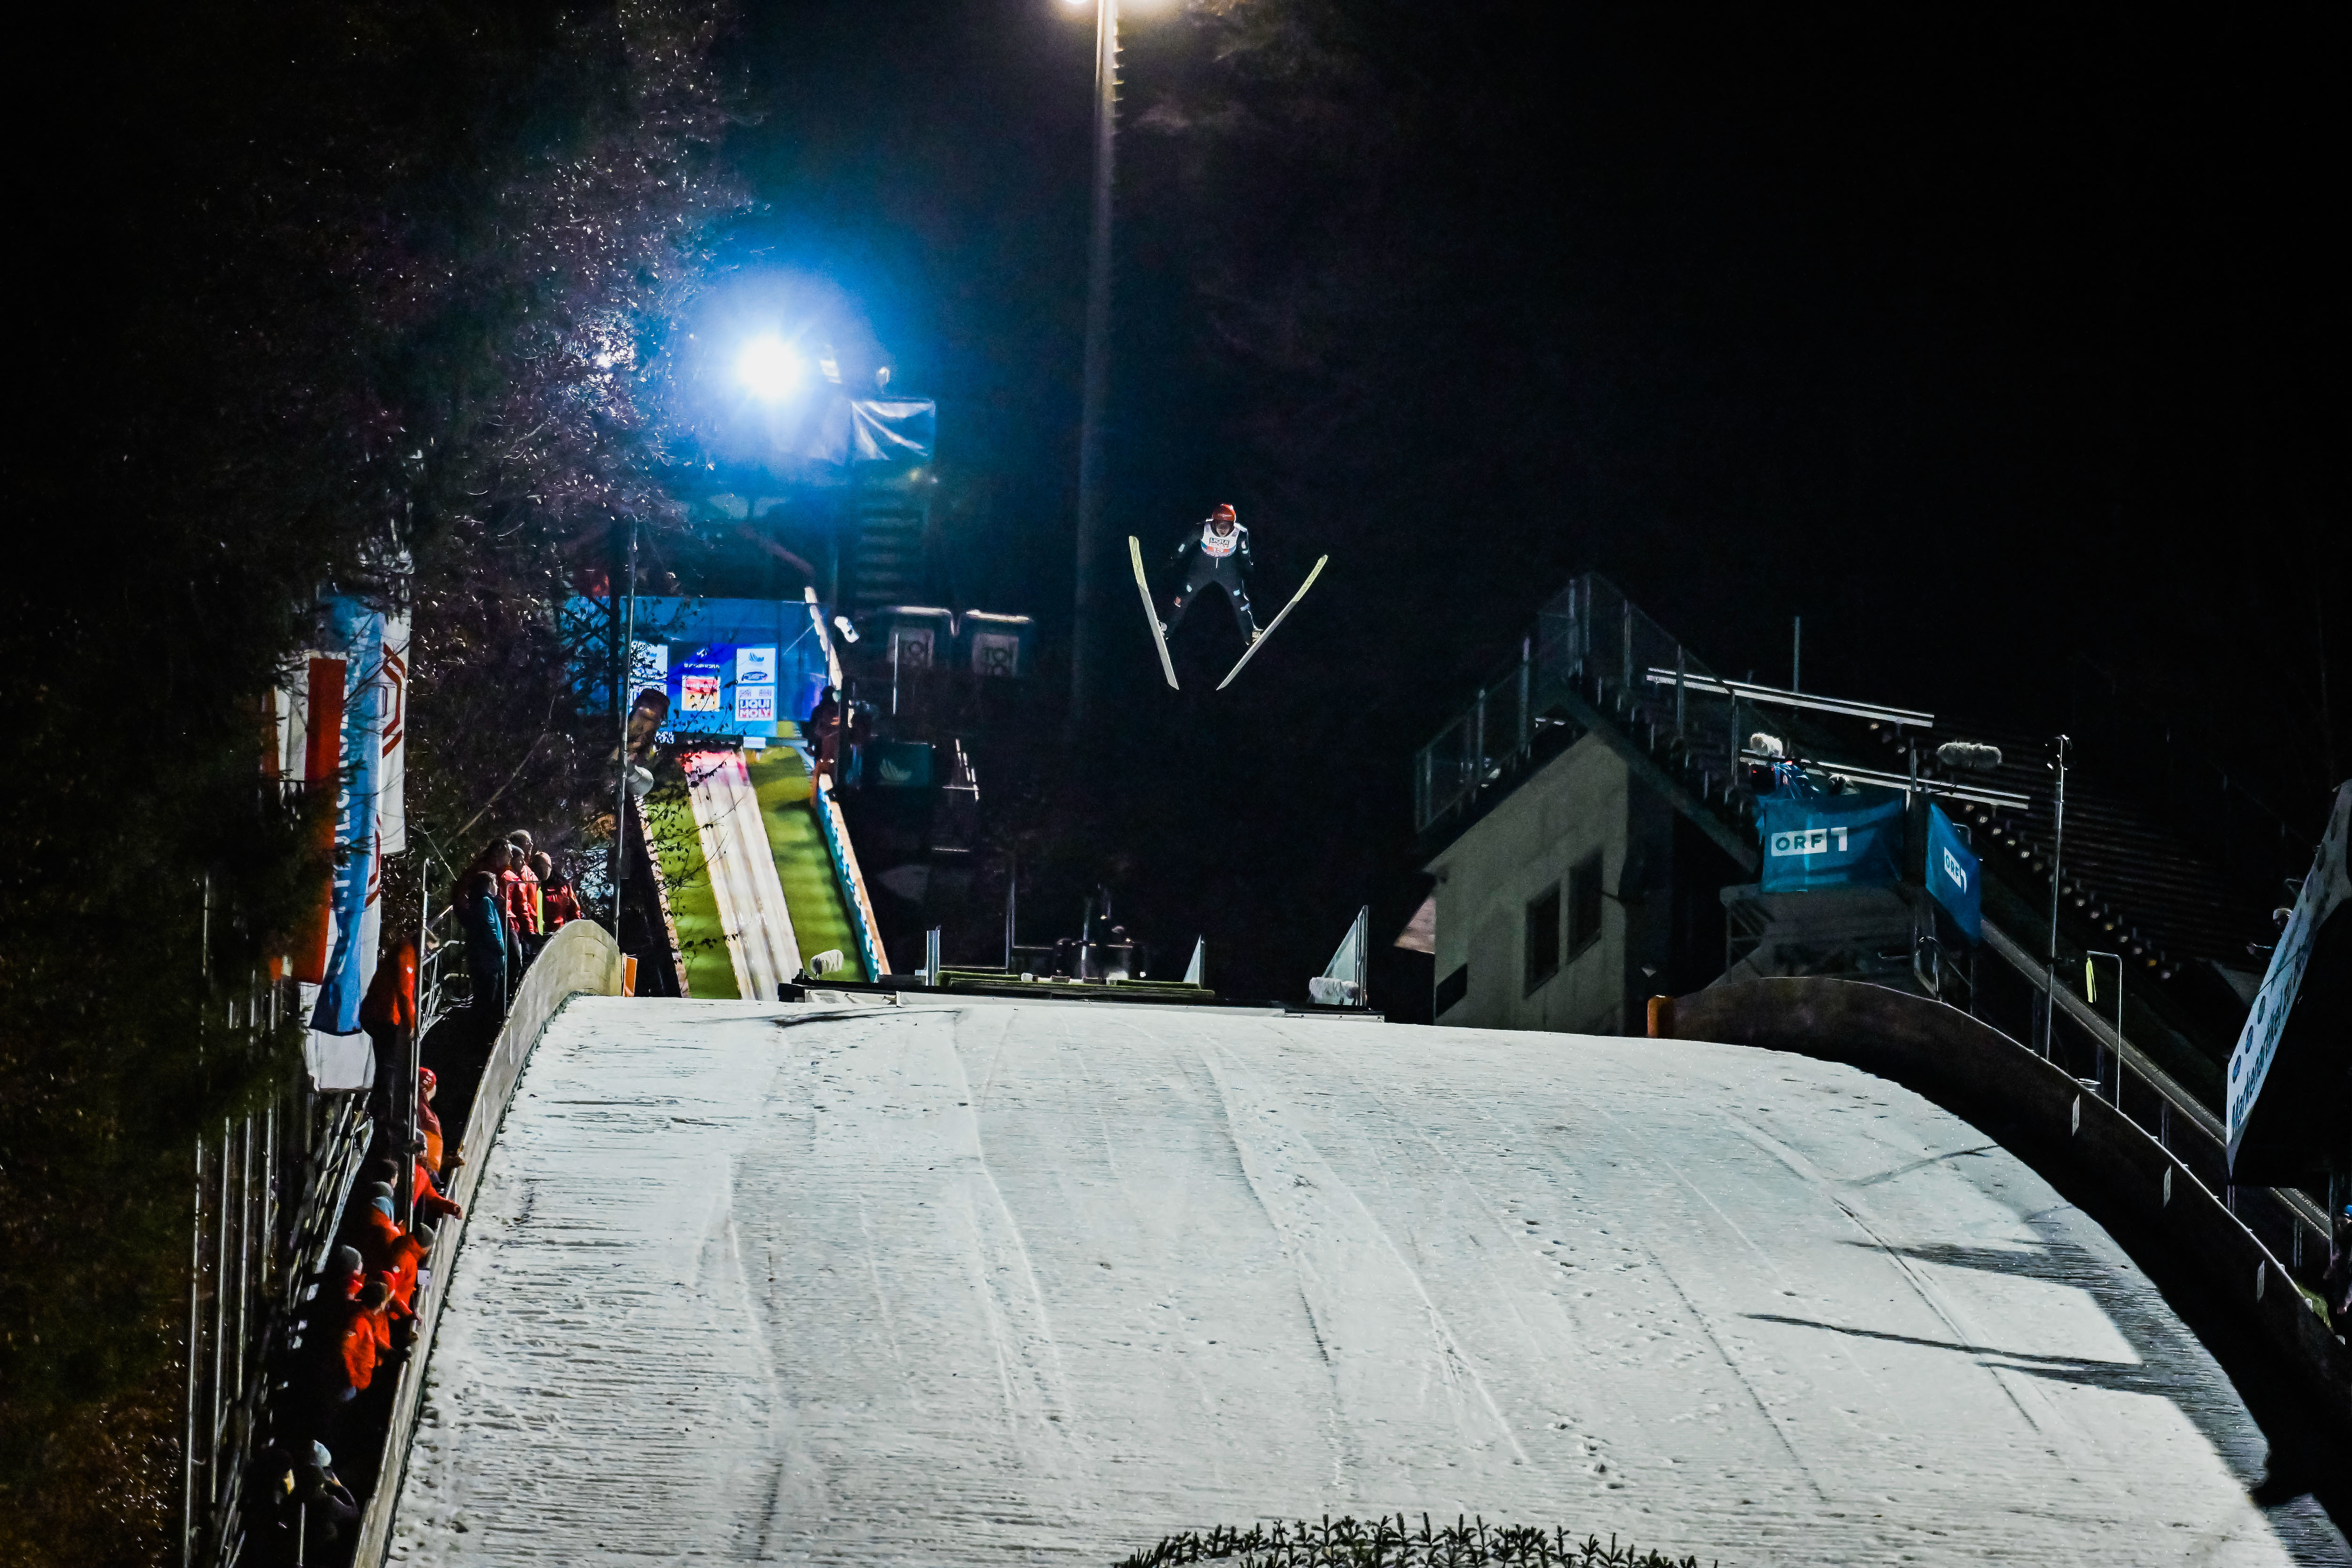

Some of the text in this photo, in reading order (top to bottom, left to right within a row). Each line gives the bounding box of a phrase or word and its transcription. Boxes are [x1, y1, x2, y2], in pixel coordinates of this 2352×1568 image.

[739, 699, 770, 709] LIQUI
[739, 708, 770, 717] MOLY
[1775, 826, 1848, 852] ORF 1
[1945, 854, 1967, 894] ORF 1
[2232, 988, 2283, 1136] Markenartikel
